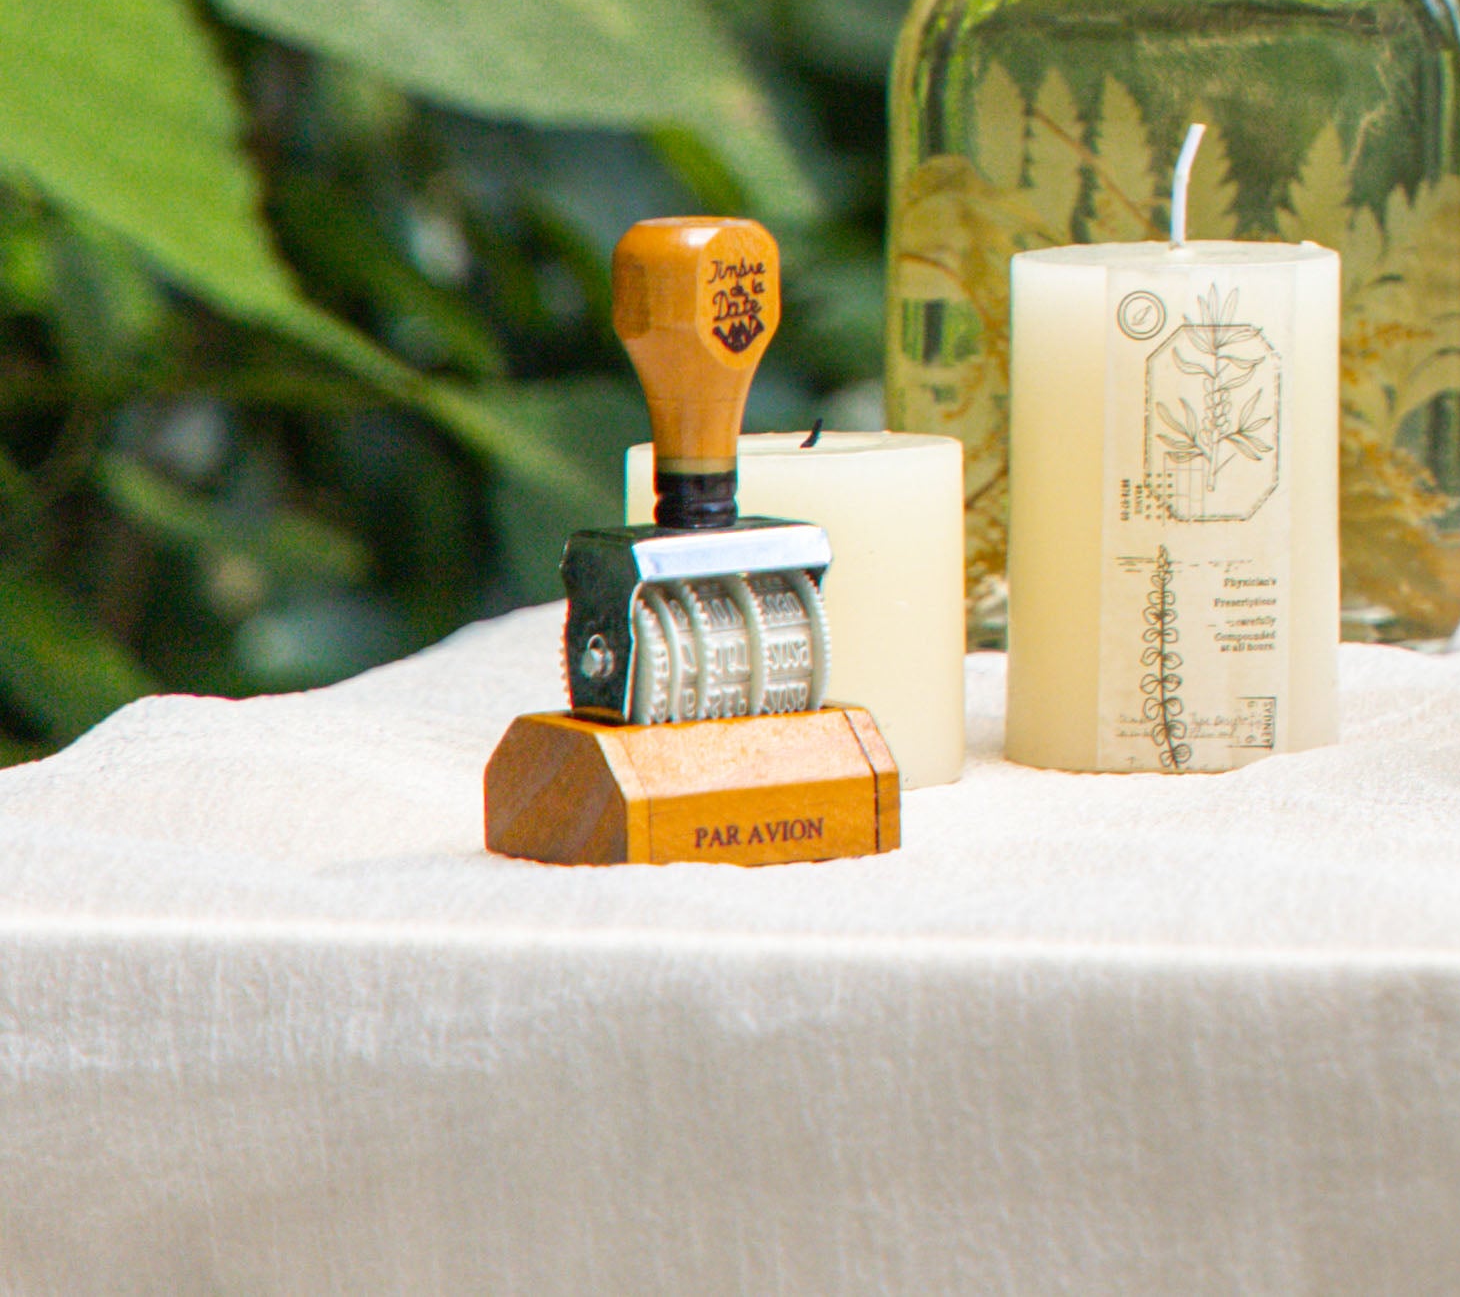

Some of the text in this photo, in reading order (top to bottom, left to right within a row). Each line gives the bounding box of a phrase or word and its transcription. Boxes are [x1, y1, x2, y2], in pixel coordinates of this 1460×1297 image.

[712, 290, 762, 322] Date
[694, 816, 824, 848] PAR AVION
